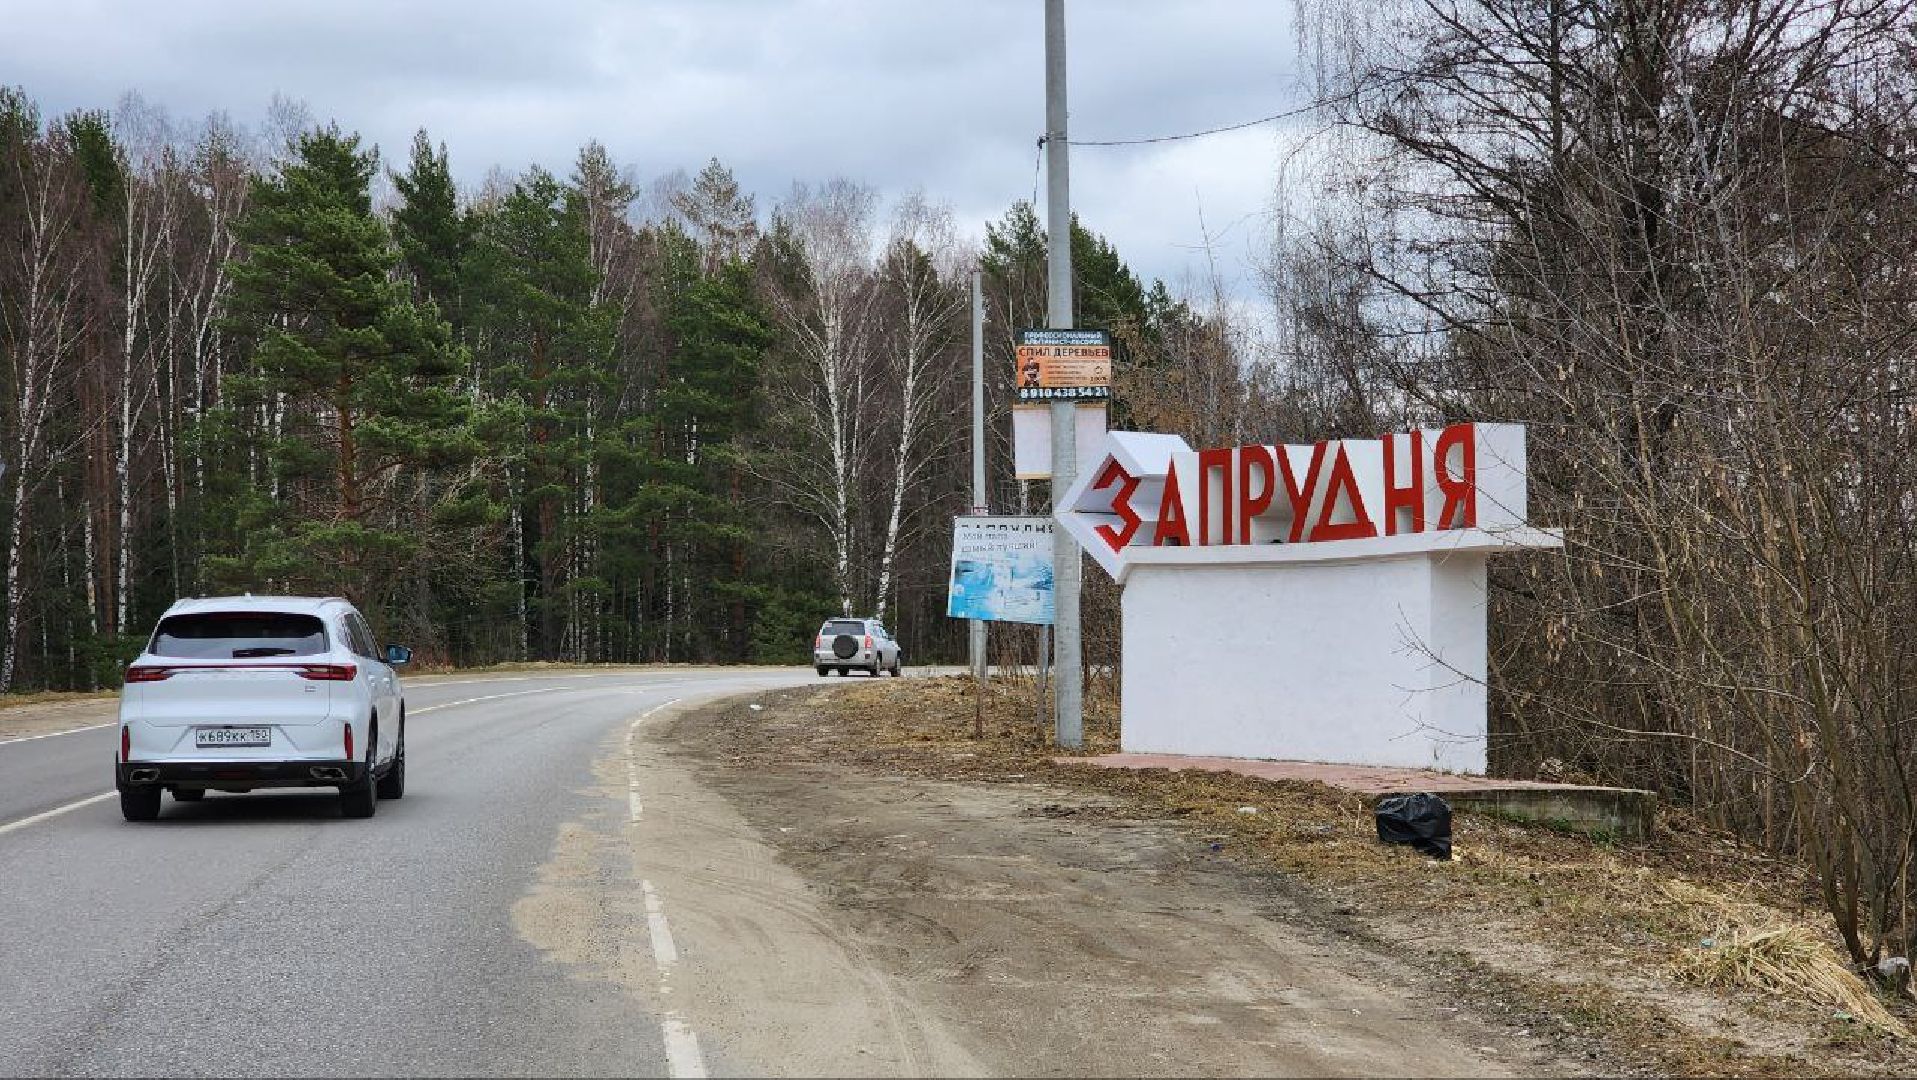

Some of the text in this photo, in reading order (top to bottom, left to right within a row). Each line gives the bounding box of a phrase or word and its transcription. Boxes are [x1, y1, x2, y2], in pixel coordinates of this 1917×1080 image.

[1024, 331, 1103, 339] ПРОФЕССИОНАЛЬНЫЙ
[1018, 348, 1109, 358] СПИЛ ДЕРЕВЬЕВ
[1092, 423, 1476, 553] ЗАПРУДНЯ
